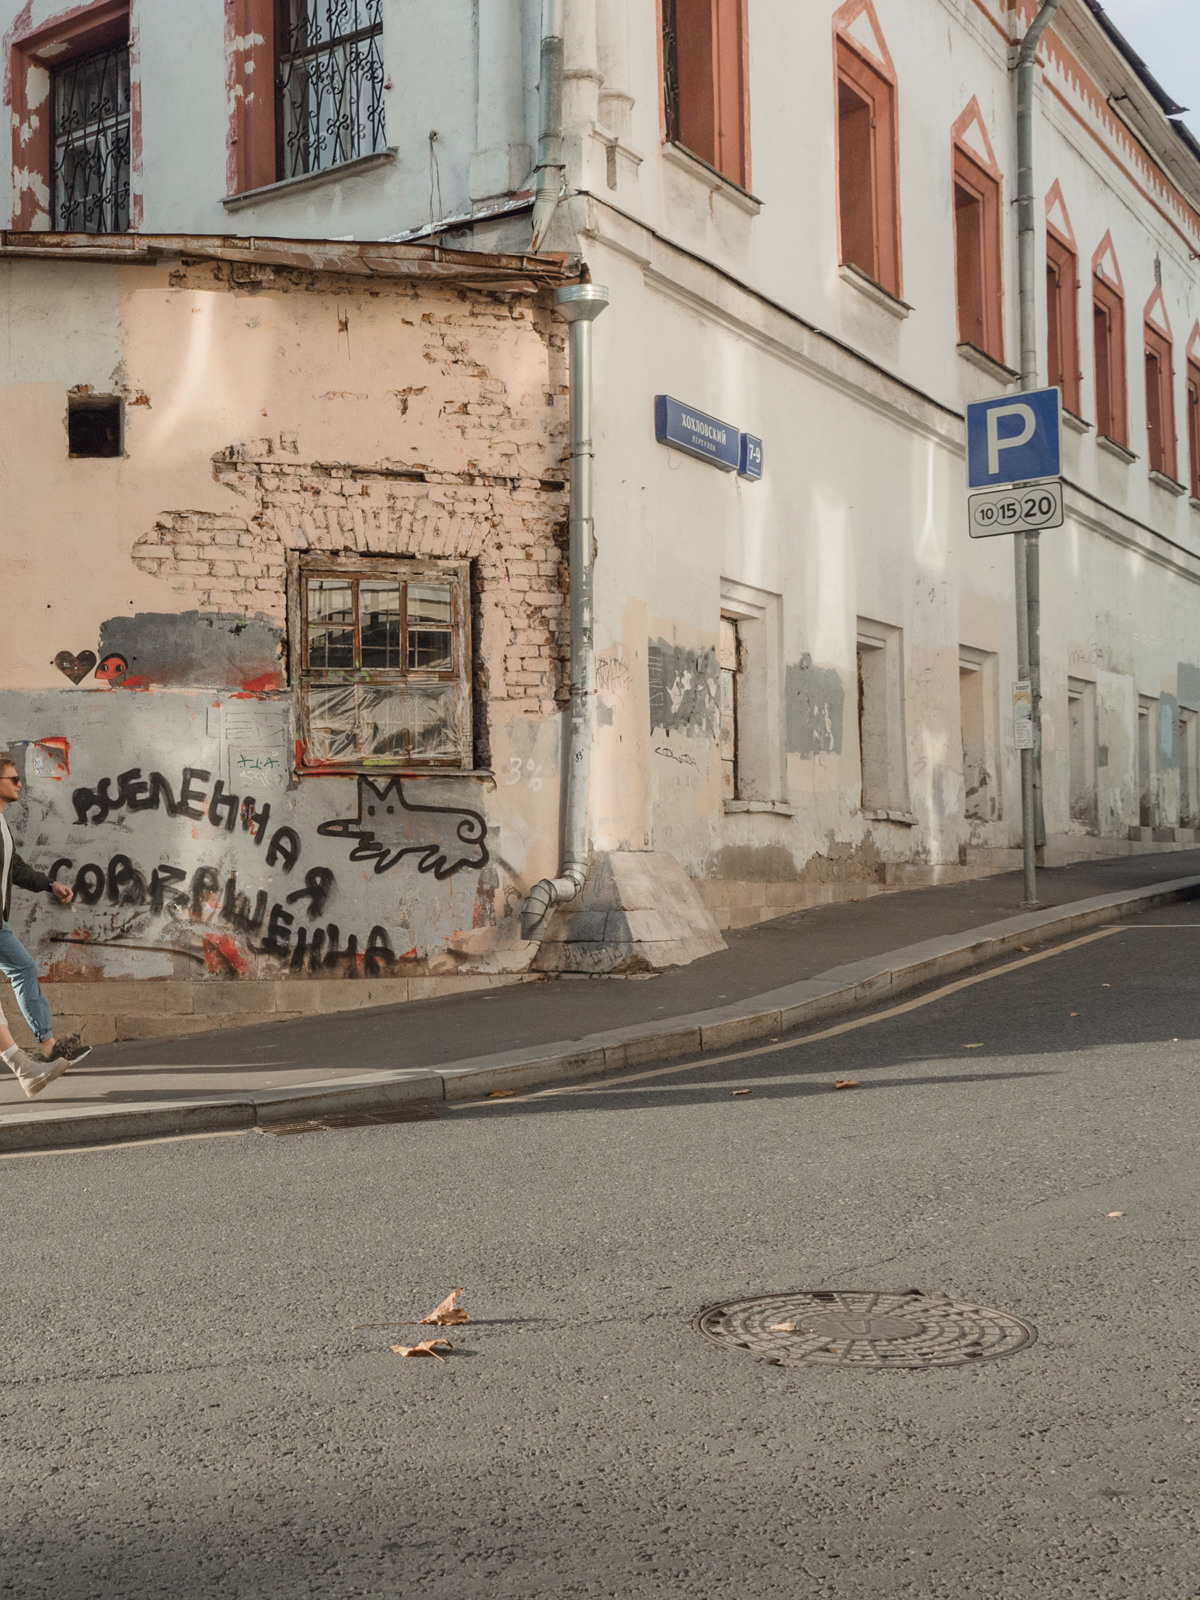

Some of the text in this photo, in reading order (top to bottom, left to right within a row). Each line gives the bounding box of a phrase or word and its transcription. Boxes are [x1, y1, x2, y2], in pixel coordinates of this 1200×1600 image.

[681, 413, 727, 446] ХОХЛОВСКИЙ
[986, 403, 1036, 475] P
[748, 443, 761, 464] 7-9
[979, 496, 1052, 521] 10 15 20
[505, 757, 543, 792] 3%
